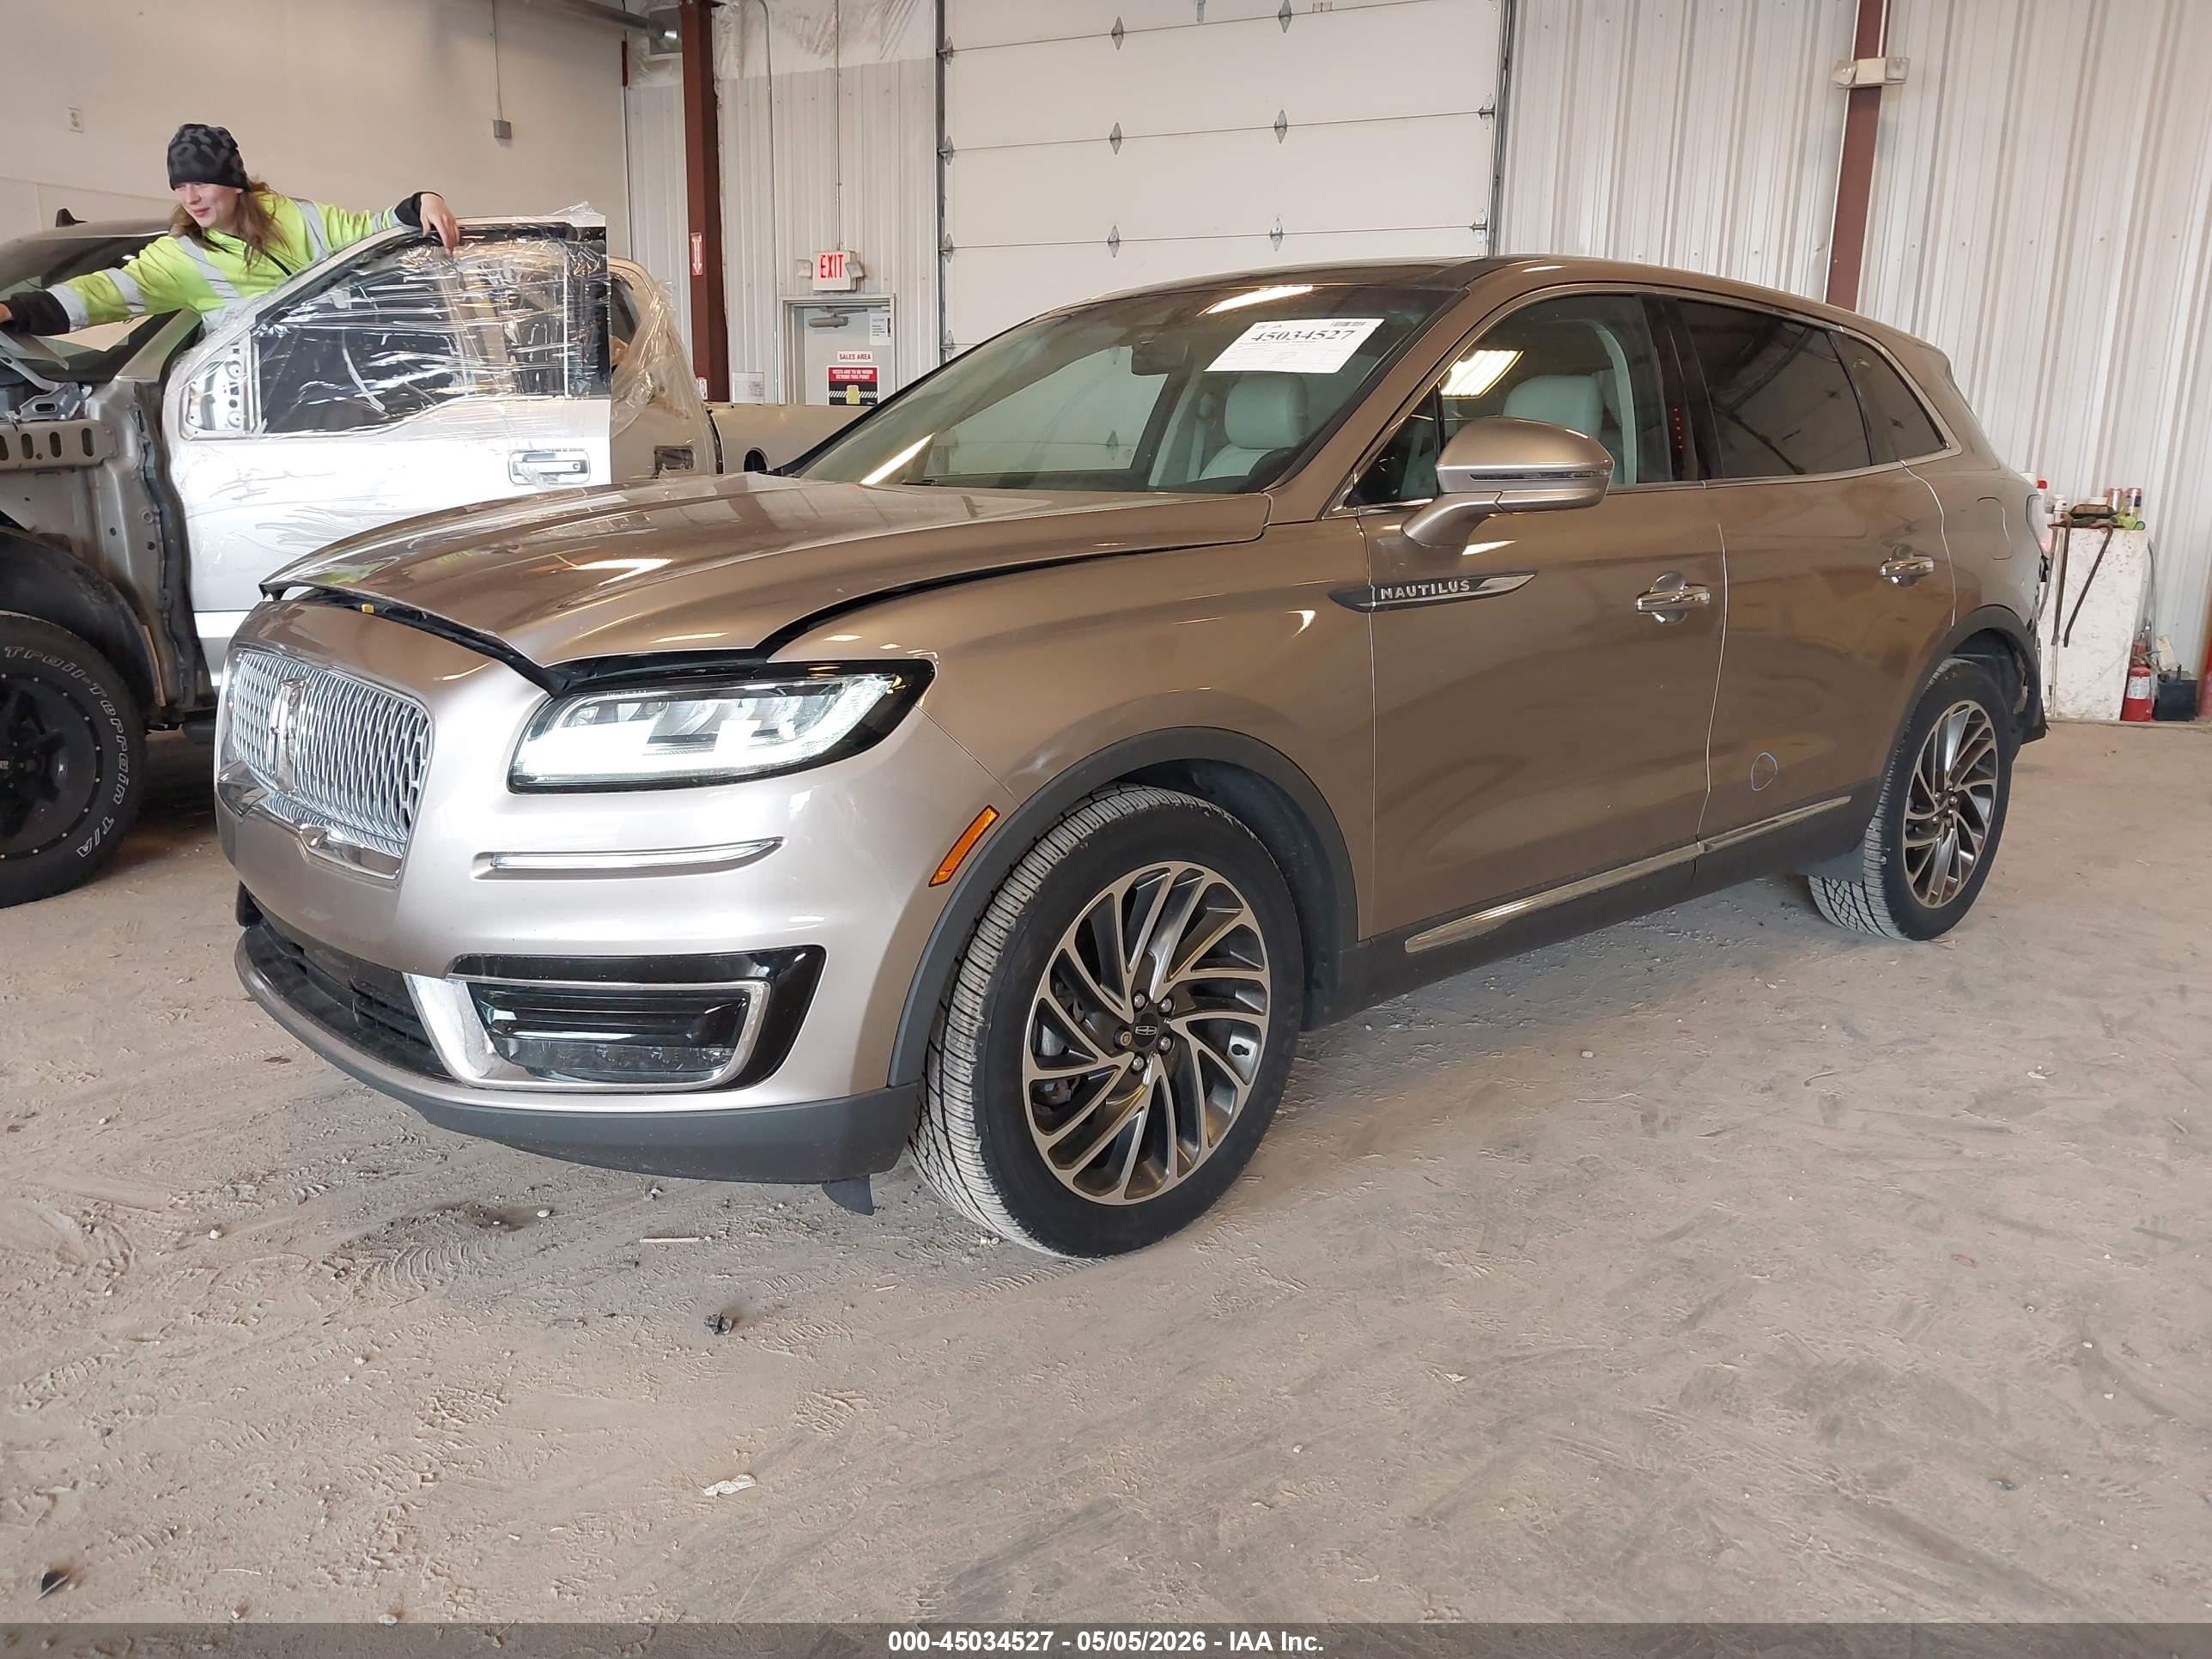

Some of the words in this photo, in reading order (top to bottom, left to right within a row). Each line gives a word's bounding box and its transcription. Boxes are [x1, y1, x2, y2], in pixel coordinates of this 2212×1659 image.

[820, 254, 843, 278] EXIT
[1251, 330, 1356, 342] 45034527
[1381, 580, 1470, 599] NAUTILUS
